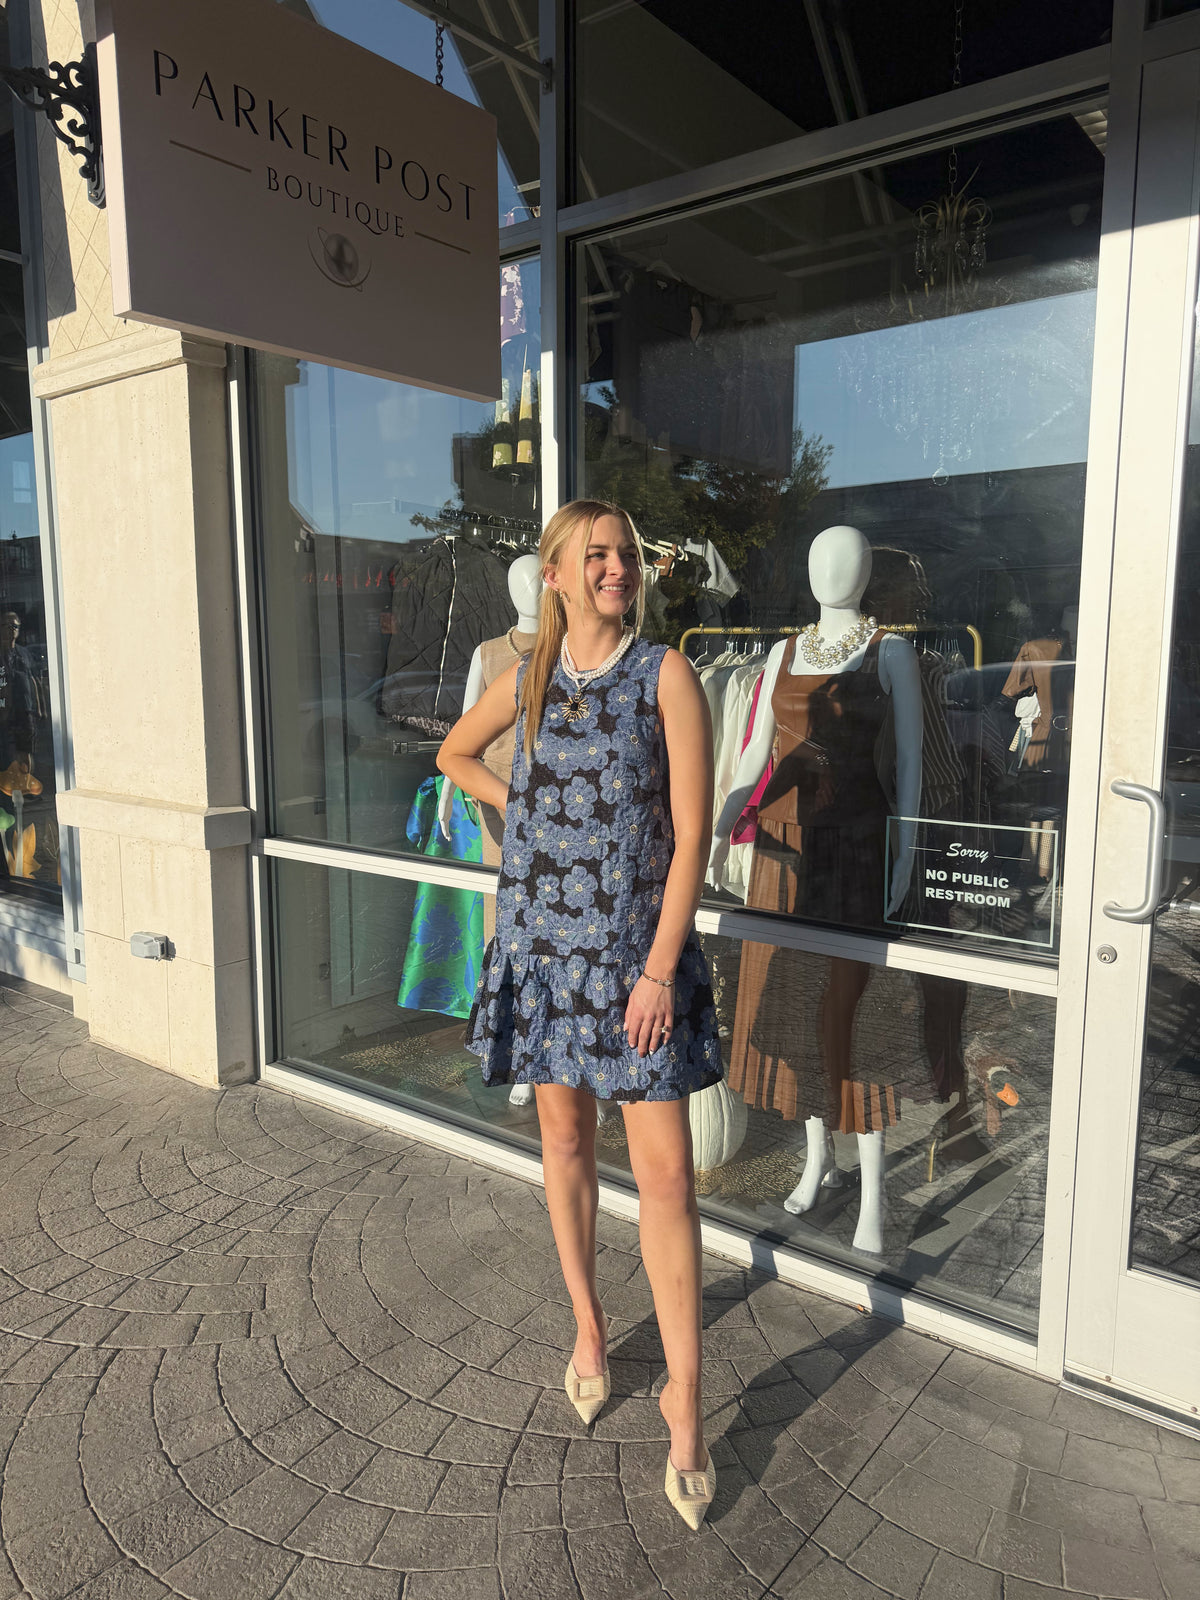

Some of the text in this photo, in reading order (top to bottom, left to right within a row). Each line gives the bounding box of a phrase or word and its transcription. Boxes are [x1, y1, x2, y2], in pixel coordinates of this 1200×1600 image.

[153, 50, 476, 220] PARKER POST
[266, 166, 405, 237] BOUTIQUE
[946, 842, 989, 863] Sorry
[925, 868, 1009, 889] NO PUBLIC
[925, 887, 1011, 908] RESTROOM
